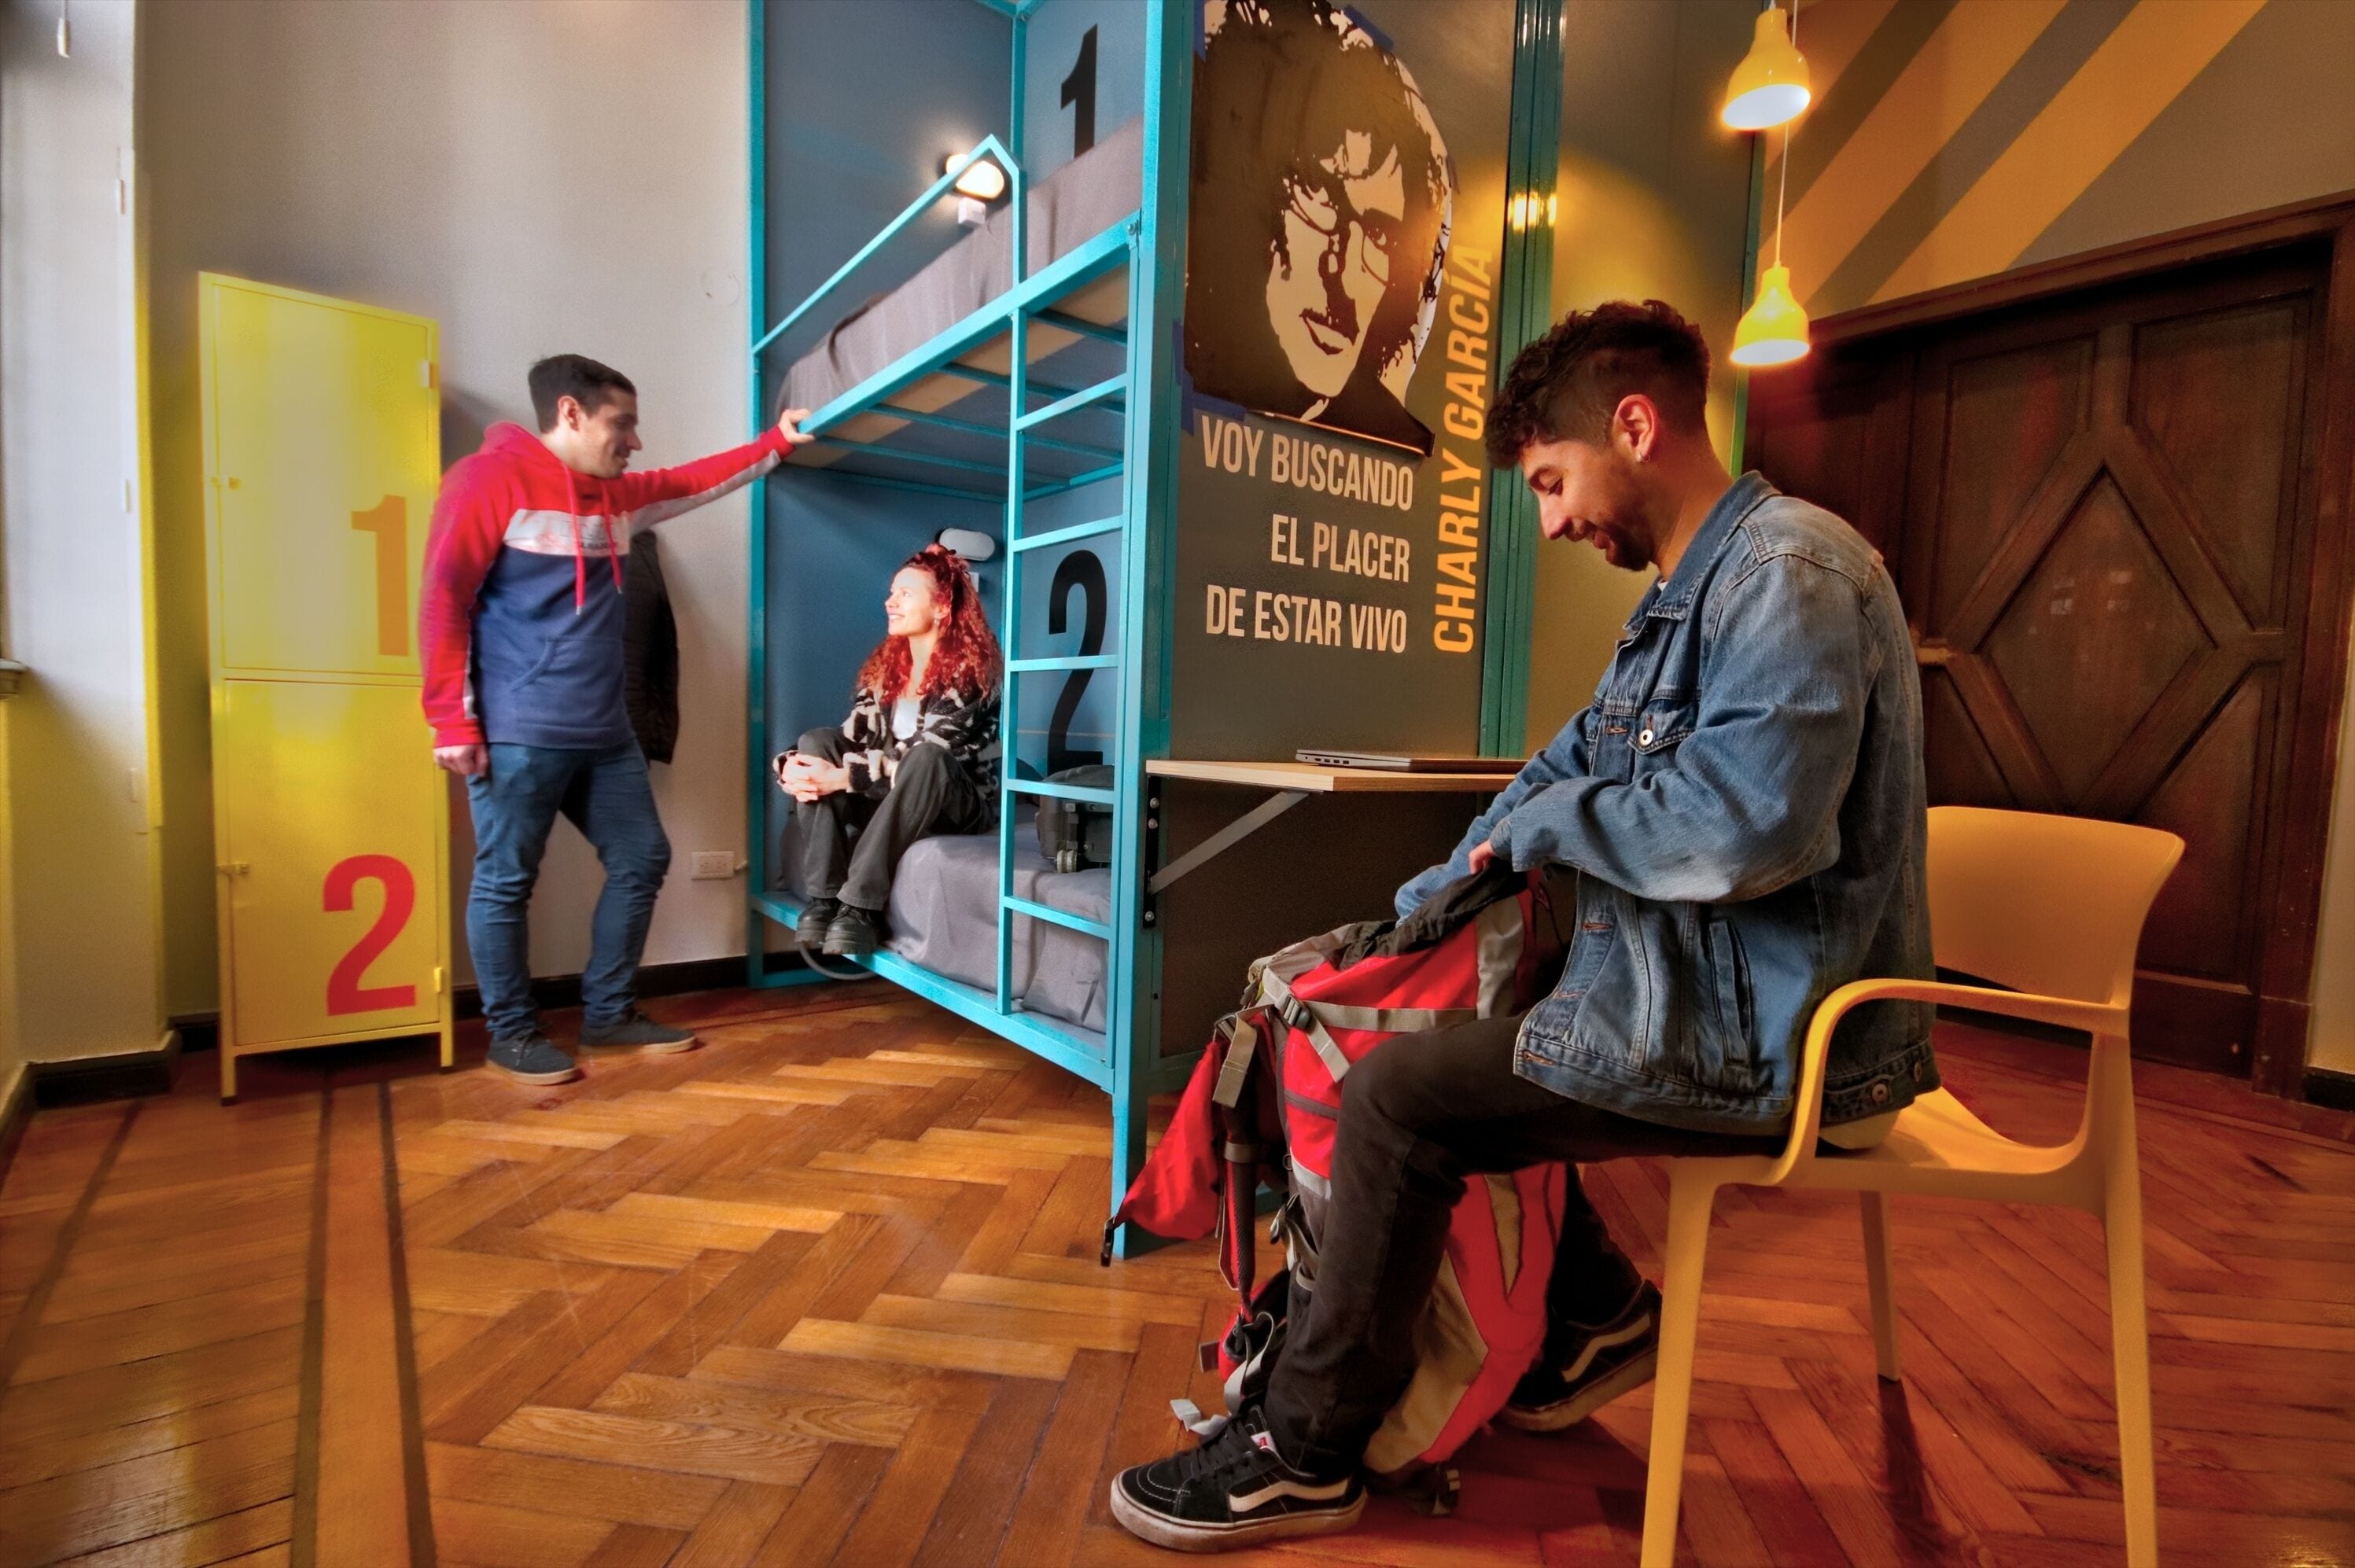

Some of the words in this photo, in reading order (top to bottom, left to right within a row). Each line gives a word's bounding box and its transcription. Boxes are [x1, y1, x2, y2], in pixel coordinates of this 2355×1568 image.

[1060, 24, 1098, 159] 1
[1443, 245, 1494, 442] GARCÍA
[1201, 415, 1264, 477] VOY
[1271, 433, 1414, 512] BUSCANDO
[351, 494, 410, 657] 1
[1206, 584, 1246, 638] DE
[1255, 591, 1341, 647] ESTAR
[1350, 605, 1407, 653] VIVO
[1271, 513, 1305, 566] EL
[1312, 521, 1410, 583] PLACER
[1433, 447, 1481, 654] CHARLY
[1047, 550, 1107, 777] 2
[322, 854, 416, 1017] 2
